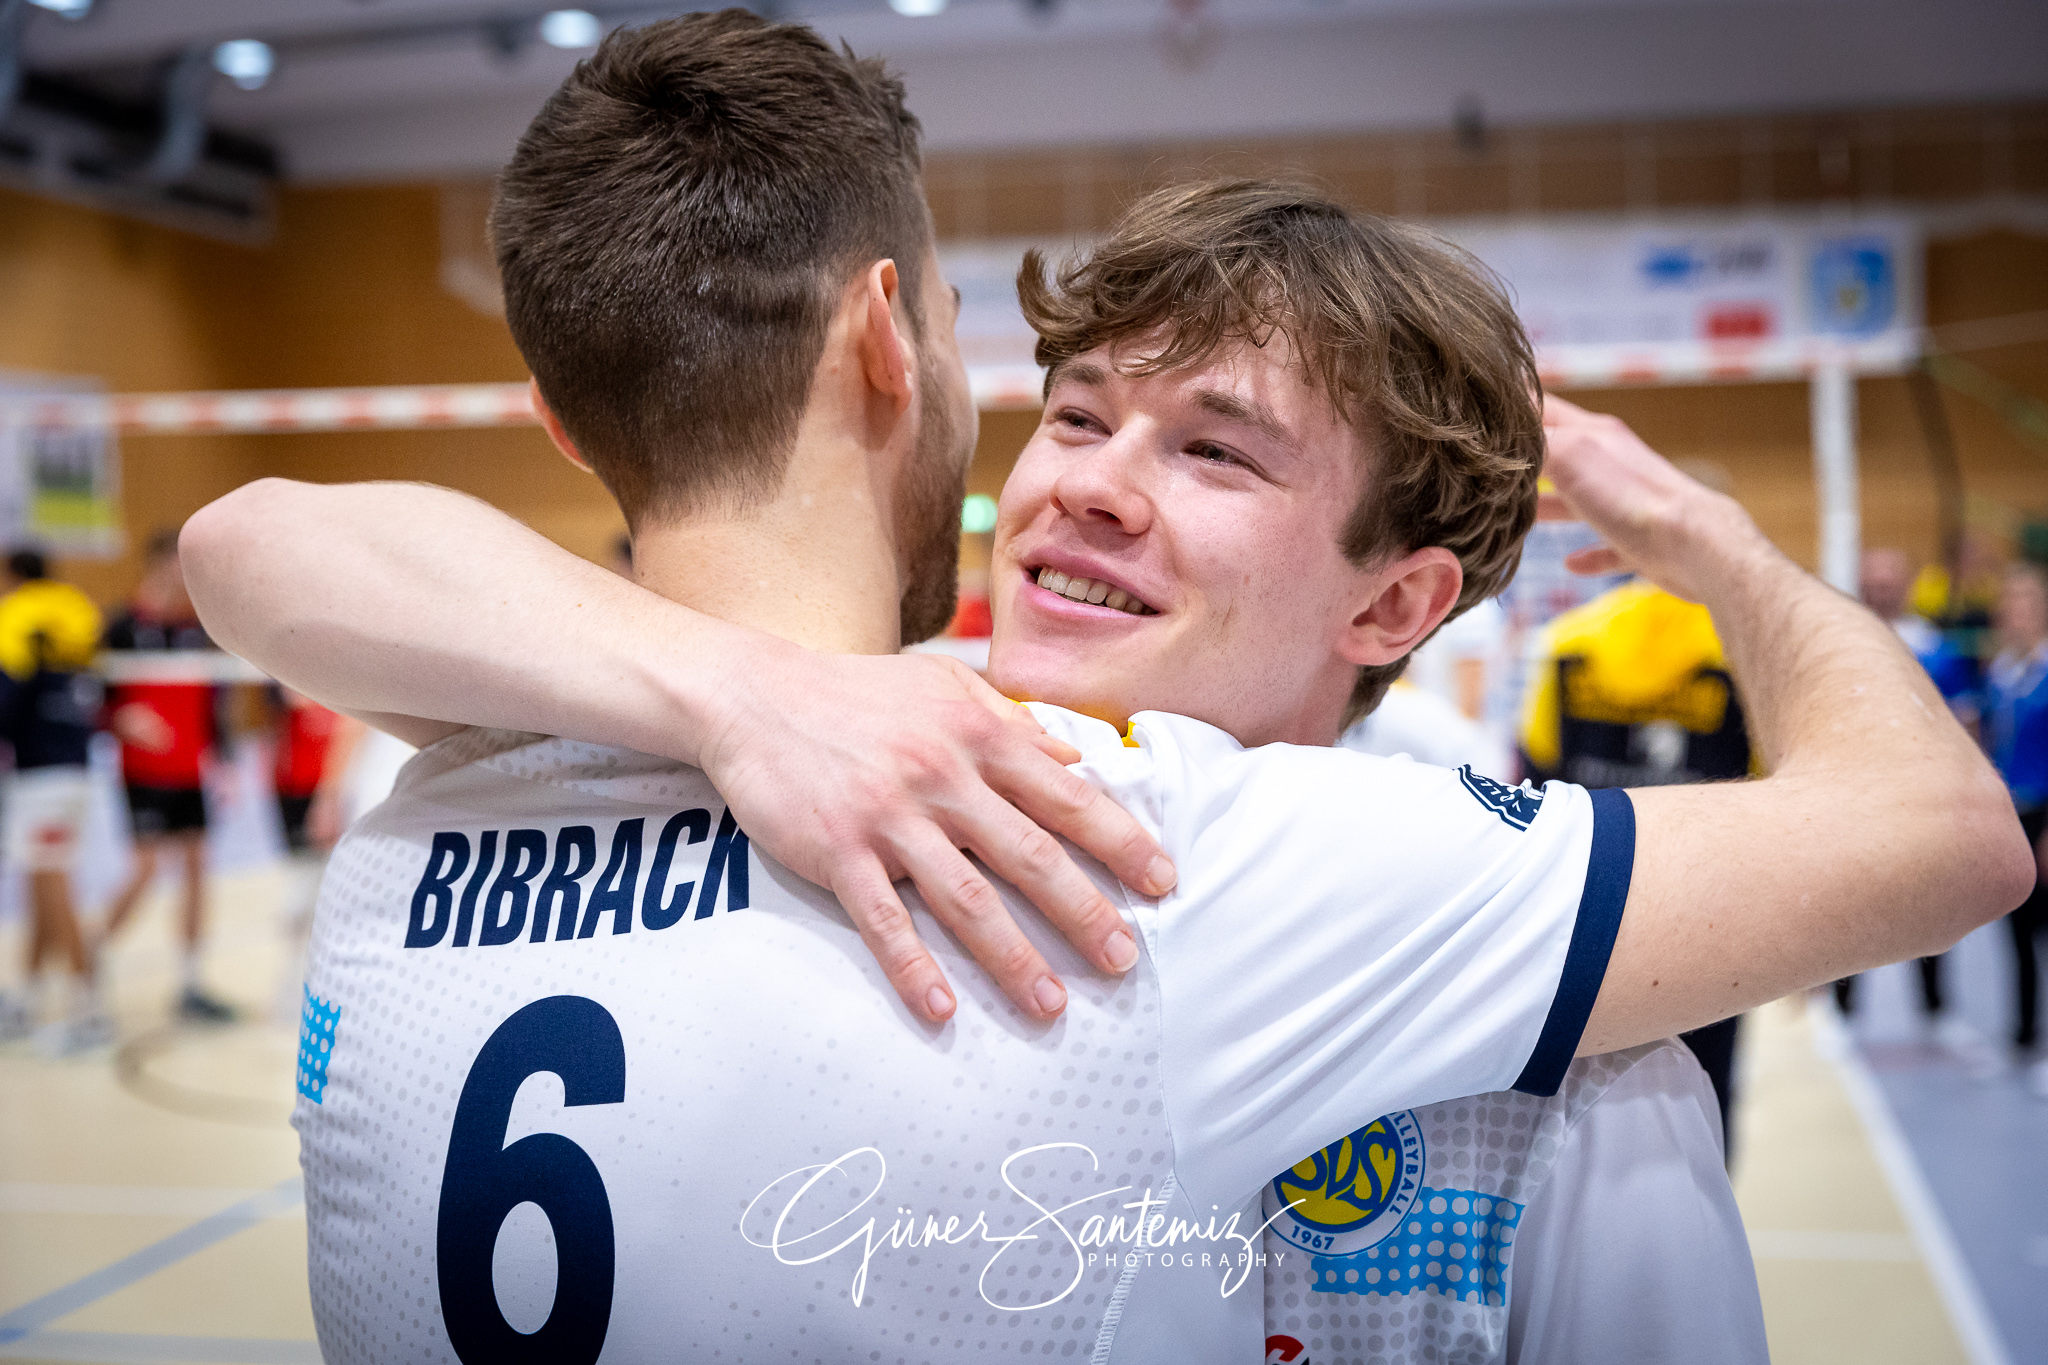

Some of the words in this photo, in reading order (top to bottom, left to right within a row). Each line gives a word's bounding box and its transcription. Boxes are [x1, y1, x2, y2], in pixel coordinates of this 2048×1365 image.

[436, 994, 627, 1365] 6
[1388, 1111, 1420, 1216] LLEYBALL
[1291, 1224, 1336, 1250] 1967
